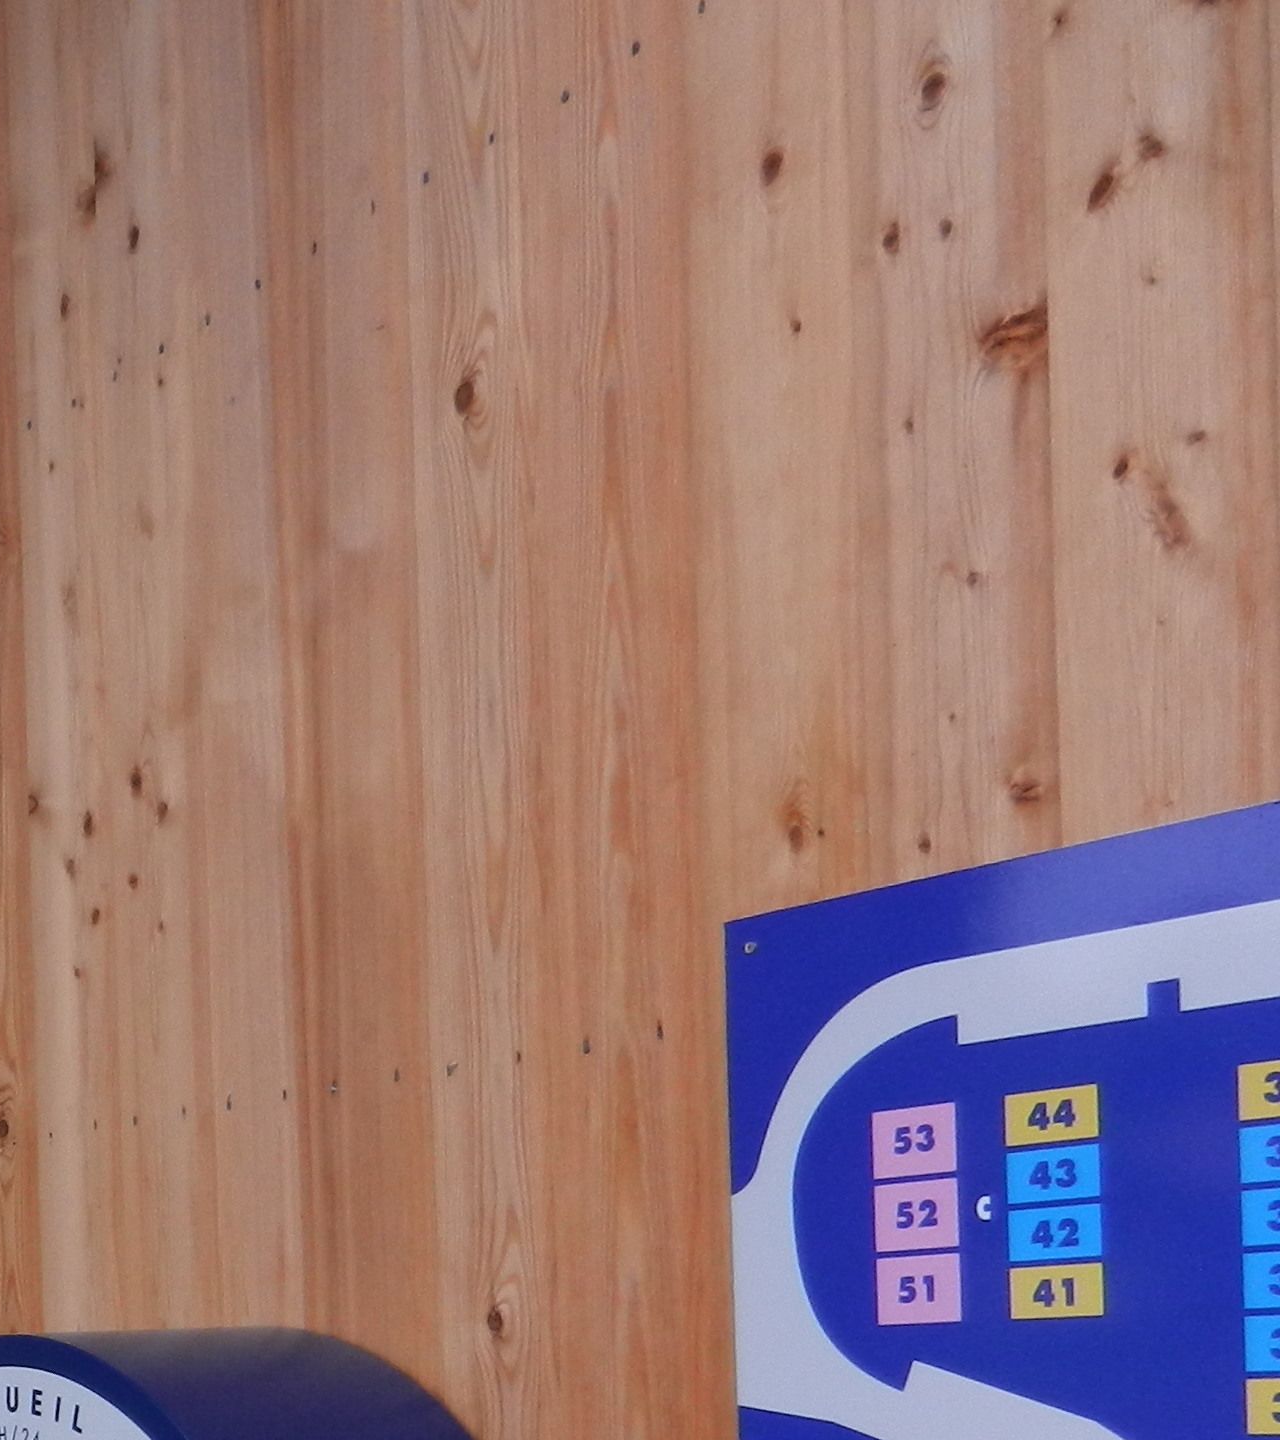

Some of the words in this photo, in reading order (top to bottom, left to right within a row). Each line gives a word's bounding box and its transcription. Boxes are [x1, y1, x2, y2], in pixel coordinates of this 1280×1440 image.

[1028, 1099, 1076, 1129] 44
[894, 1125, 936, 1153] 53
[1029, 1159, 1078, 1188] 43
[896, 1200, 938, 1228] 52
[1031, 1218, 1080, 1248] 42
[898, 1275, 935, 1303] 51
[1033, 1278, 1075, 1306] 41
